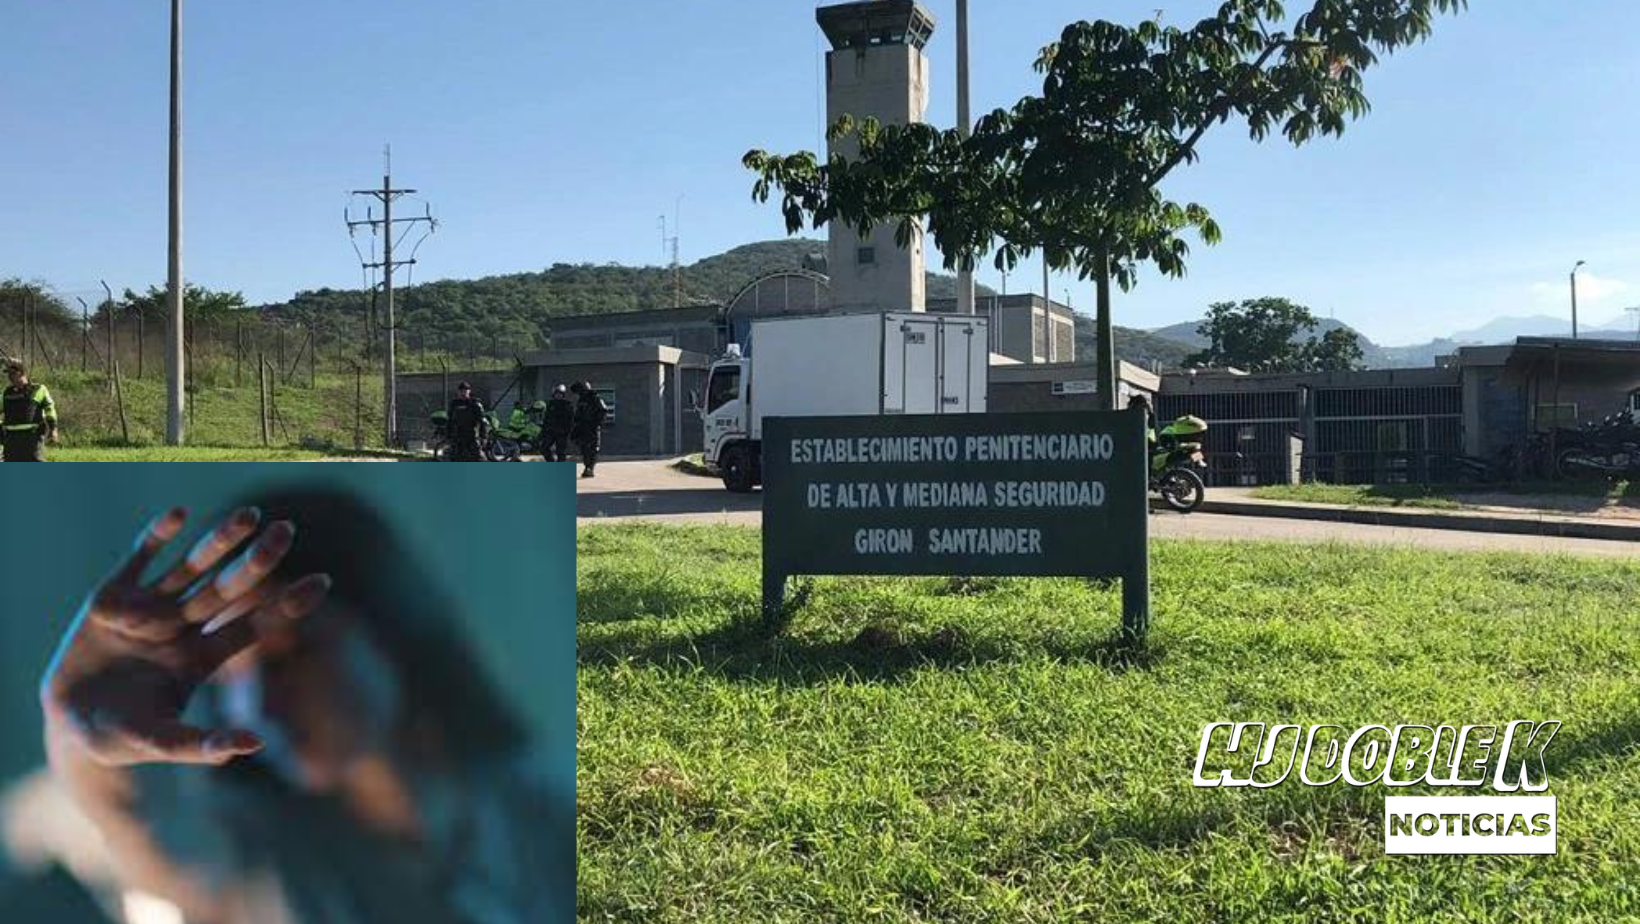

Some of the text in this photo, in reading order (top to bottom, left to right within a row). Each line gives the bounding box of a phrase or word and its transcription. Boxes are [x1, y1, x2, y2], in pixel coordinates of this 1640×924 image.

[790, 434, 1114, 462] ESTABLECIMIENTO PENITENCIARIO
[808, 481, 1105, 508] DE ALTA Y MEDIANA SEGURIDAD
[855, 528, 1042, 554] GIRON SANTANDER
